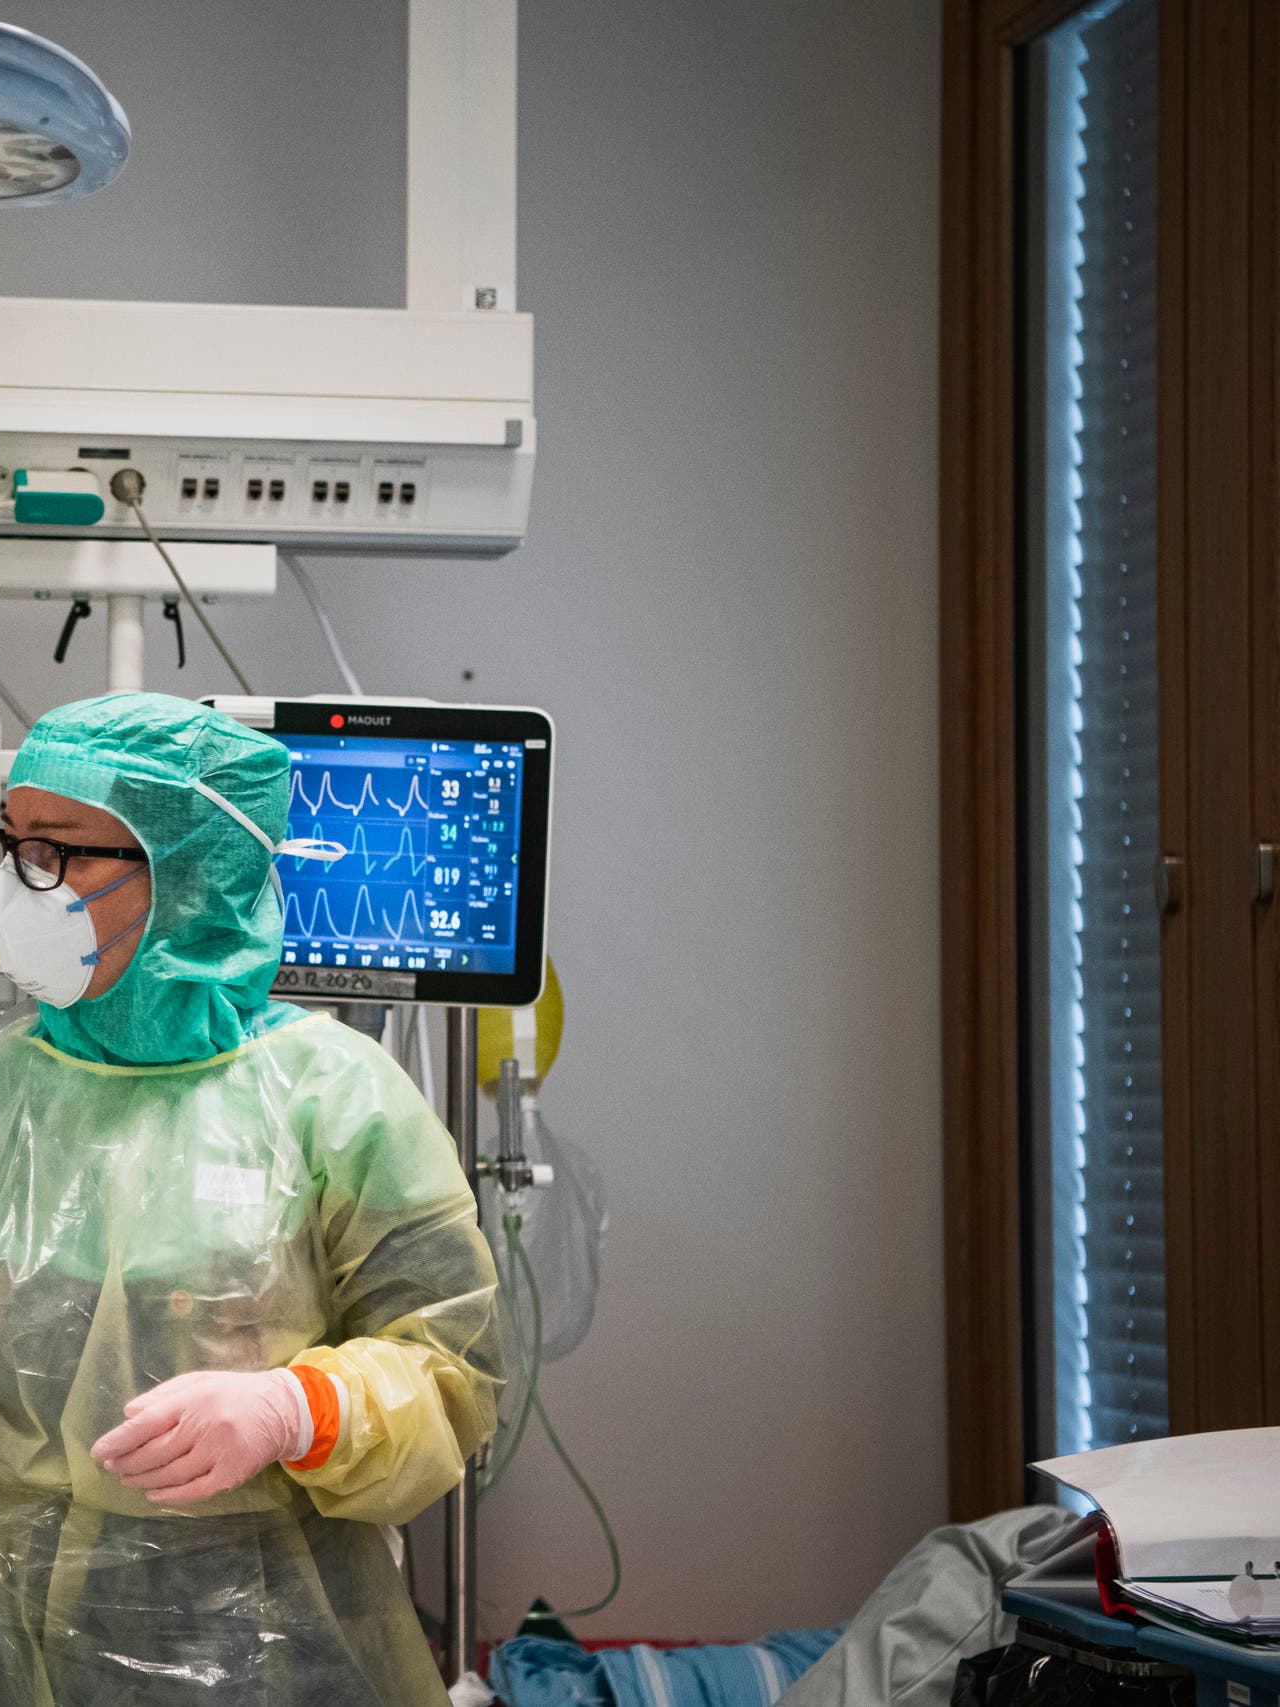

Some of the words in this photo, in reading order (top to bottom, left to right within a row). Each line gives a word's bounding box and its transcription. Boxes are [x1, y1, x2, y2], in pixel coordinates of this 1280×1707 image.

[347, 715, 392, 726] MAQUET
[441, 779, 460, 798] 33
[440, 823, 457, 842] 34
[433, 866, 460, 886] 819
[429, 909, 461, 930] 32.6
